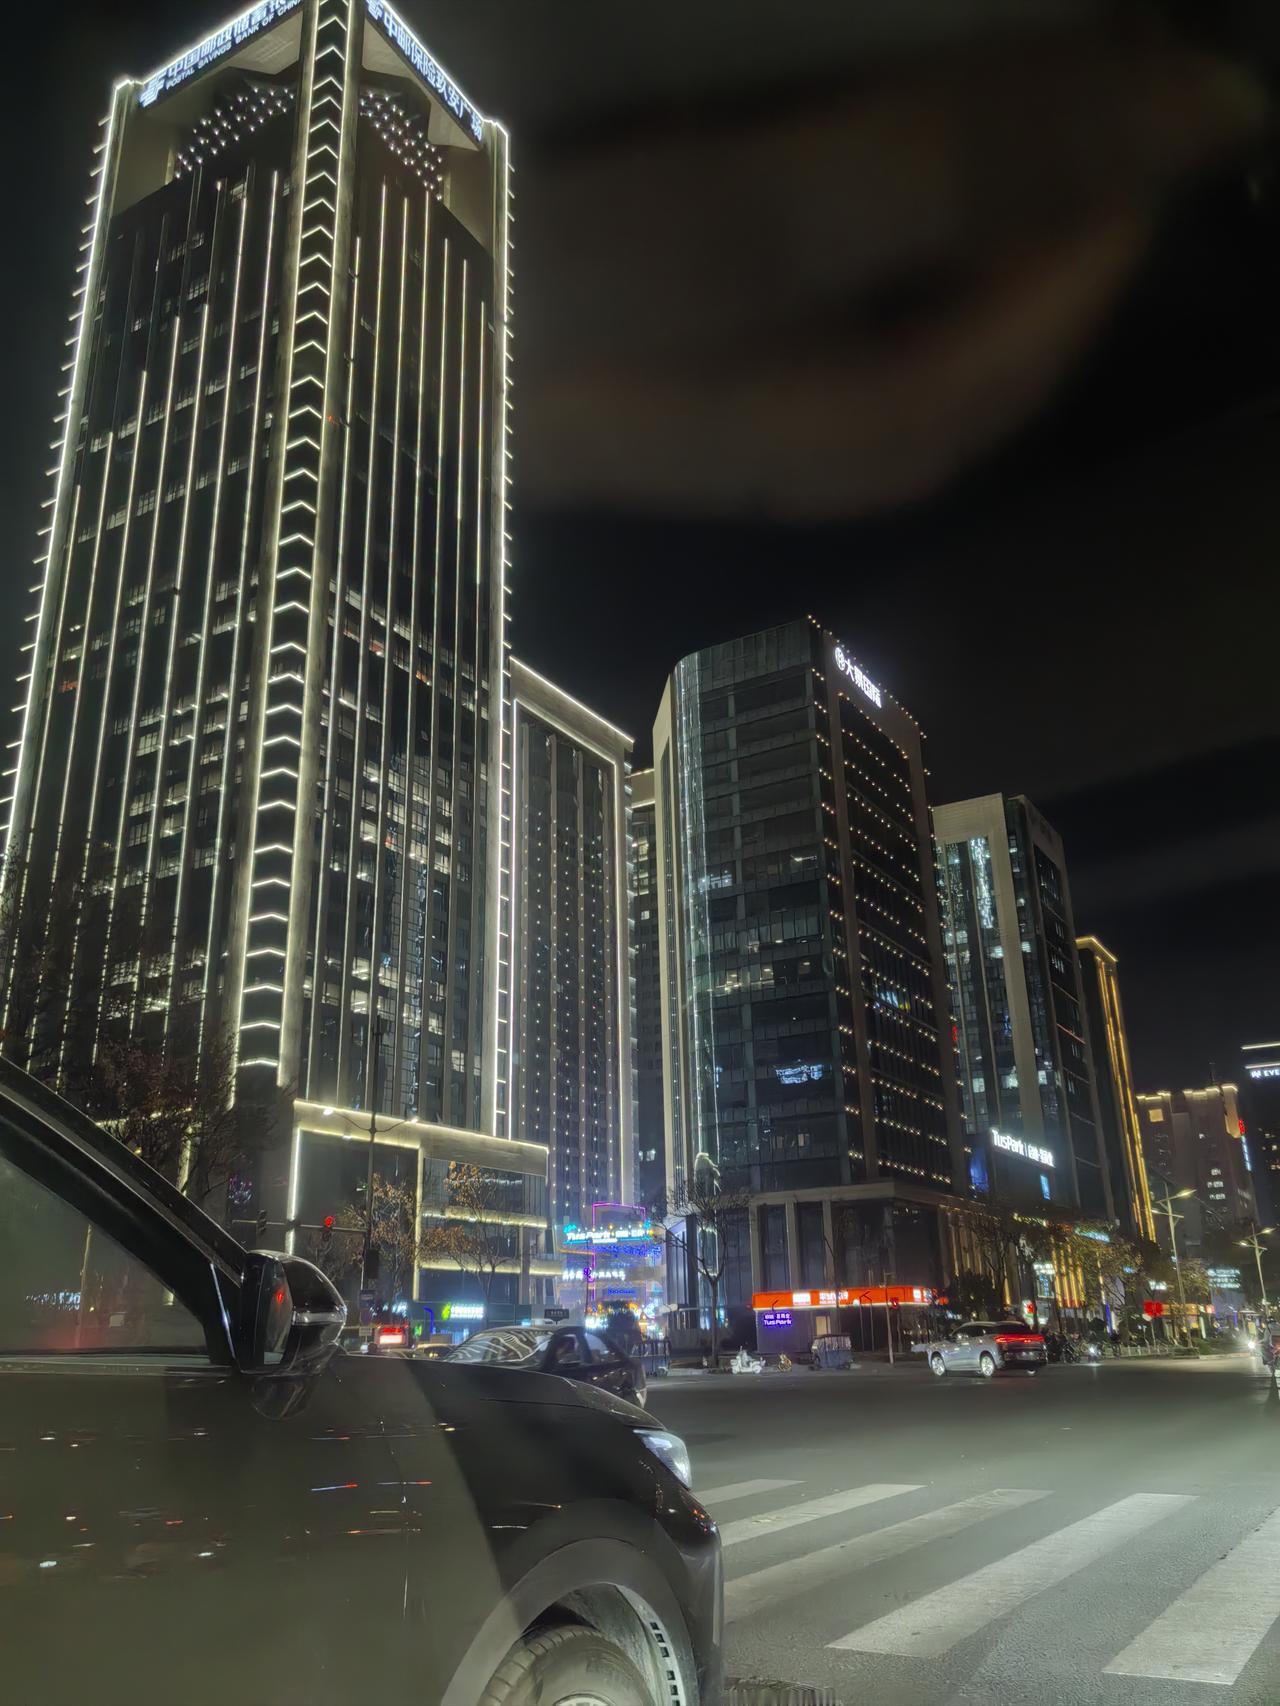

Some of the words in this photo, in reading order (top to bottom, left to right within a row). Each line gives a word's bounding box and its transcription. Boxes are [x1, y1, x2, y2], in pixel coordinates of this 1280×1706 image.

[166, 68, 195, 90] POSTAL
[198, 41, 232, 69] SAVINGS
[235, 24, 260, 44] BANK
[262, 14, 275, 27] OF
[991, 1129, 1025, 1156] TusPark
